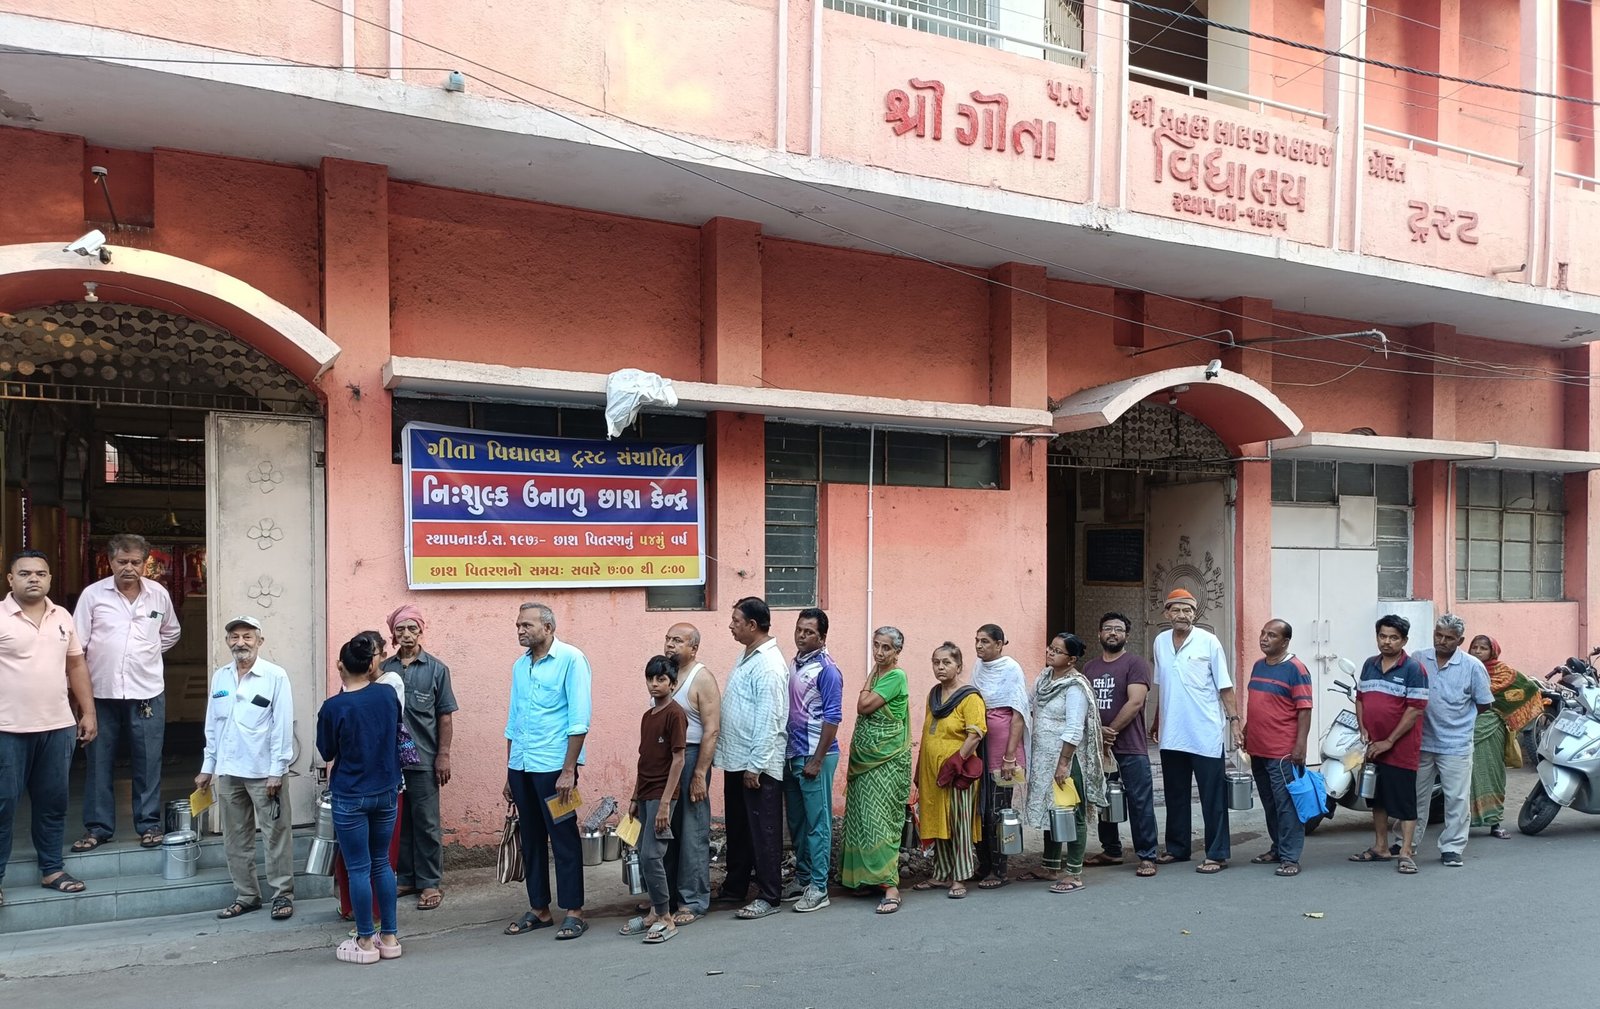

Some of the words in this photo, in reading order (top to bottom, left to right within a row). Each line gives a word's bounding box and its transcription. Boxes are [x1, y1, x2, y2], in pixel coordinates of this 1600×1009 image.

[1129, 95, 1155, 128] શ્રી
[885, 77, 945, 141] શ્રી
[955, 90, 1057, 161] ગીતા
[1407, 199, 1479, 245] ટ્રસ્ટ
[427, 437, 476, 460] ગીતા
[571, 450, 607, 468] ટ્રસ્ટ
[617, 446, 685, 467] સંચાલિત
[523, 479, 588, 518] ઉનાળુ
[597, 489, 641, 509] છાશ
[649, 481, 689, 511] કેન્દ્ર
[553, 534, 579, 546] છાશ
[585, 531, 634, 550] વિતરણનું
[670, 531, 688, 546] વર્ષ
[430, 566, 457, 577] છાશ
[465, 562, 522, 577] વિતરણનો
[571, 562, 601, 575] સવારે
[640, 561, 654, 575] થી
[1099, 688, 1109, 699] IT
